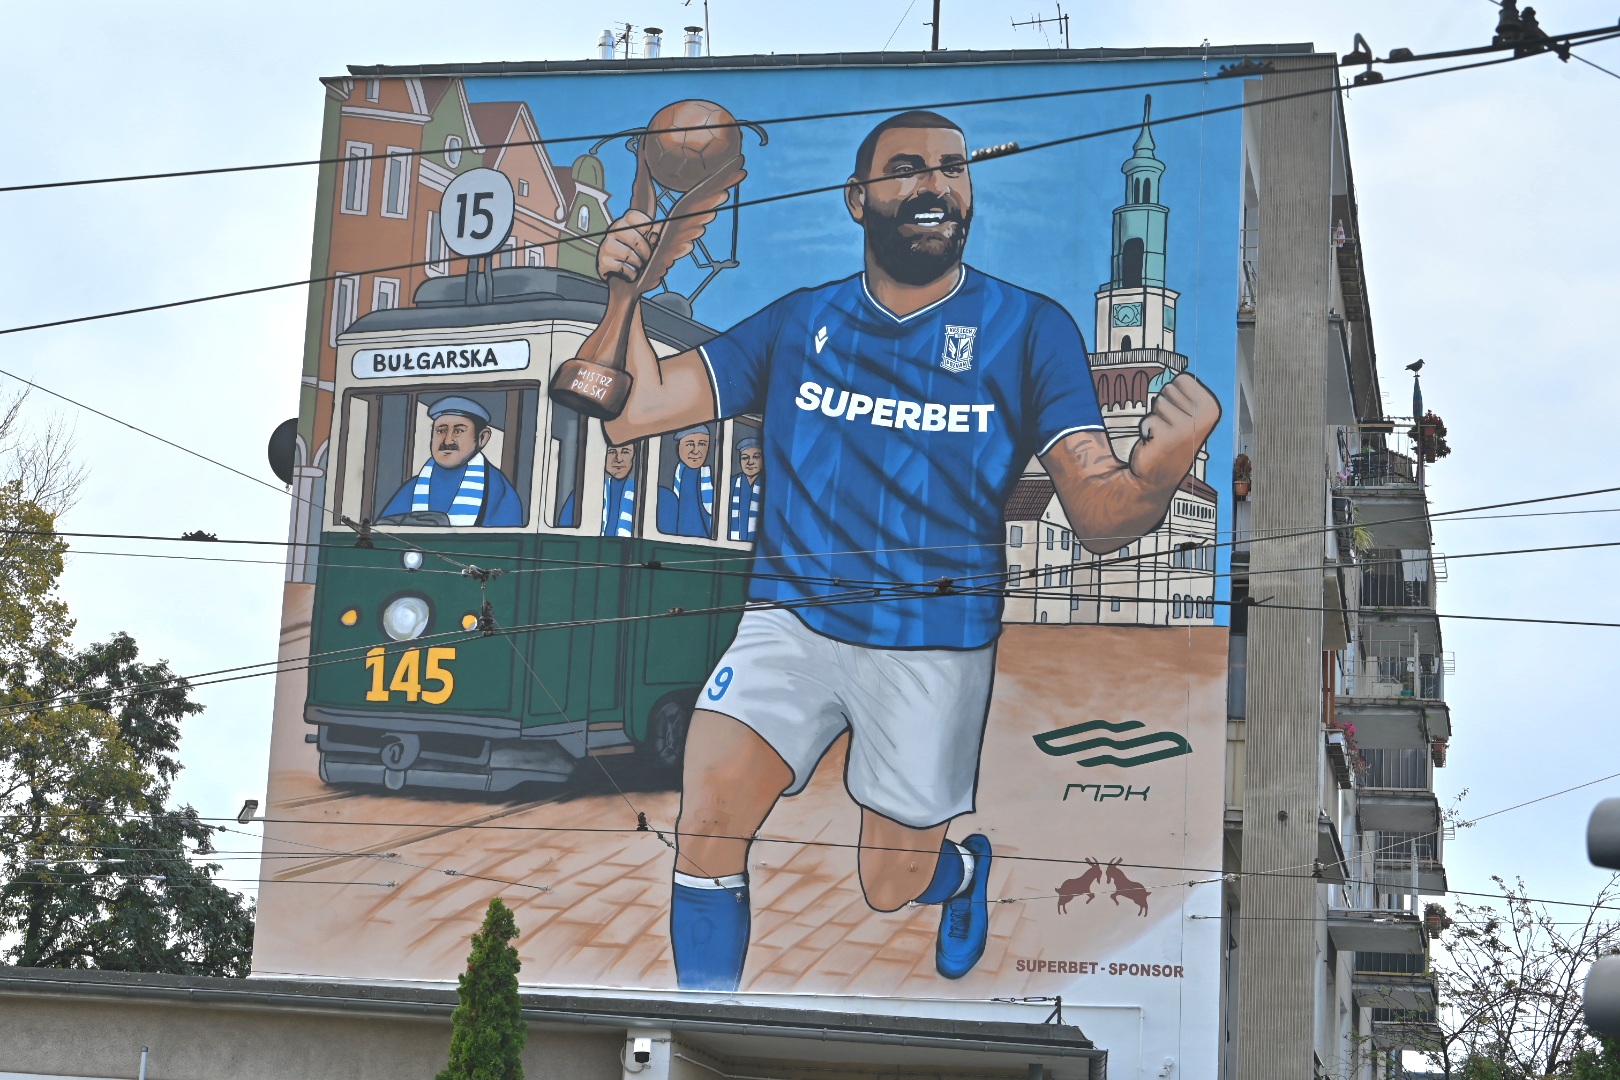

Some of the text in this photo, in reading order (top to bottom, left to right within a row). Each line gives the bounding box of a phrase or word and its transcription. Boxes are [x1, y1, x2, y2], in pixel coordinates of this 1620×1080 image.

[456, 192, 494, 240] 15
[373, 347, 499, 373] BUŁGARSKA
[570, 379, 607, 401] POLSKI
[578, 367, 613, 387] MISTRZ
[795, 381, 995, 433] SUPERBET
[365, 646, 456, 705] 145
[708, 666, 734, 702] 9
[1062, 783, 1151, 802] MPK
[1015, 959, 1099, 975] SUPERBET
[1108, 962, 1184, 978] SPONSOR
